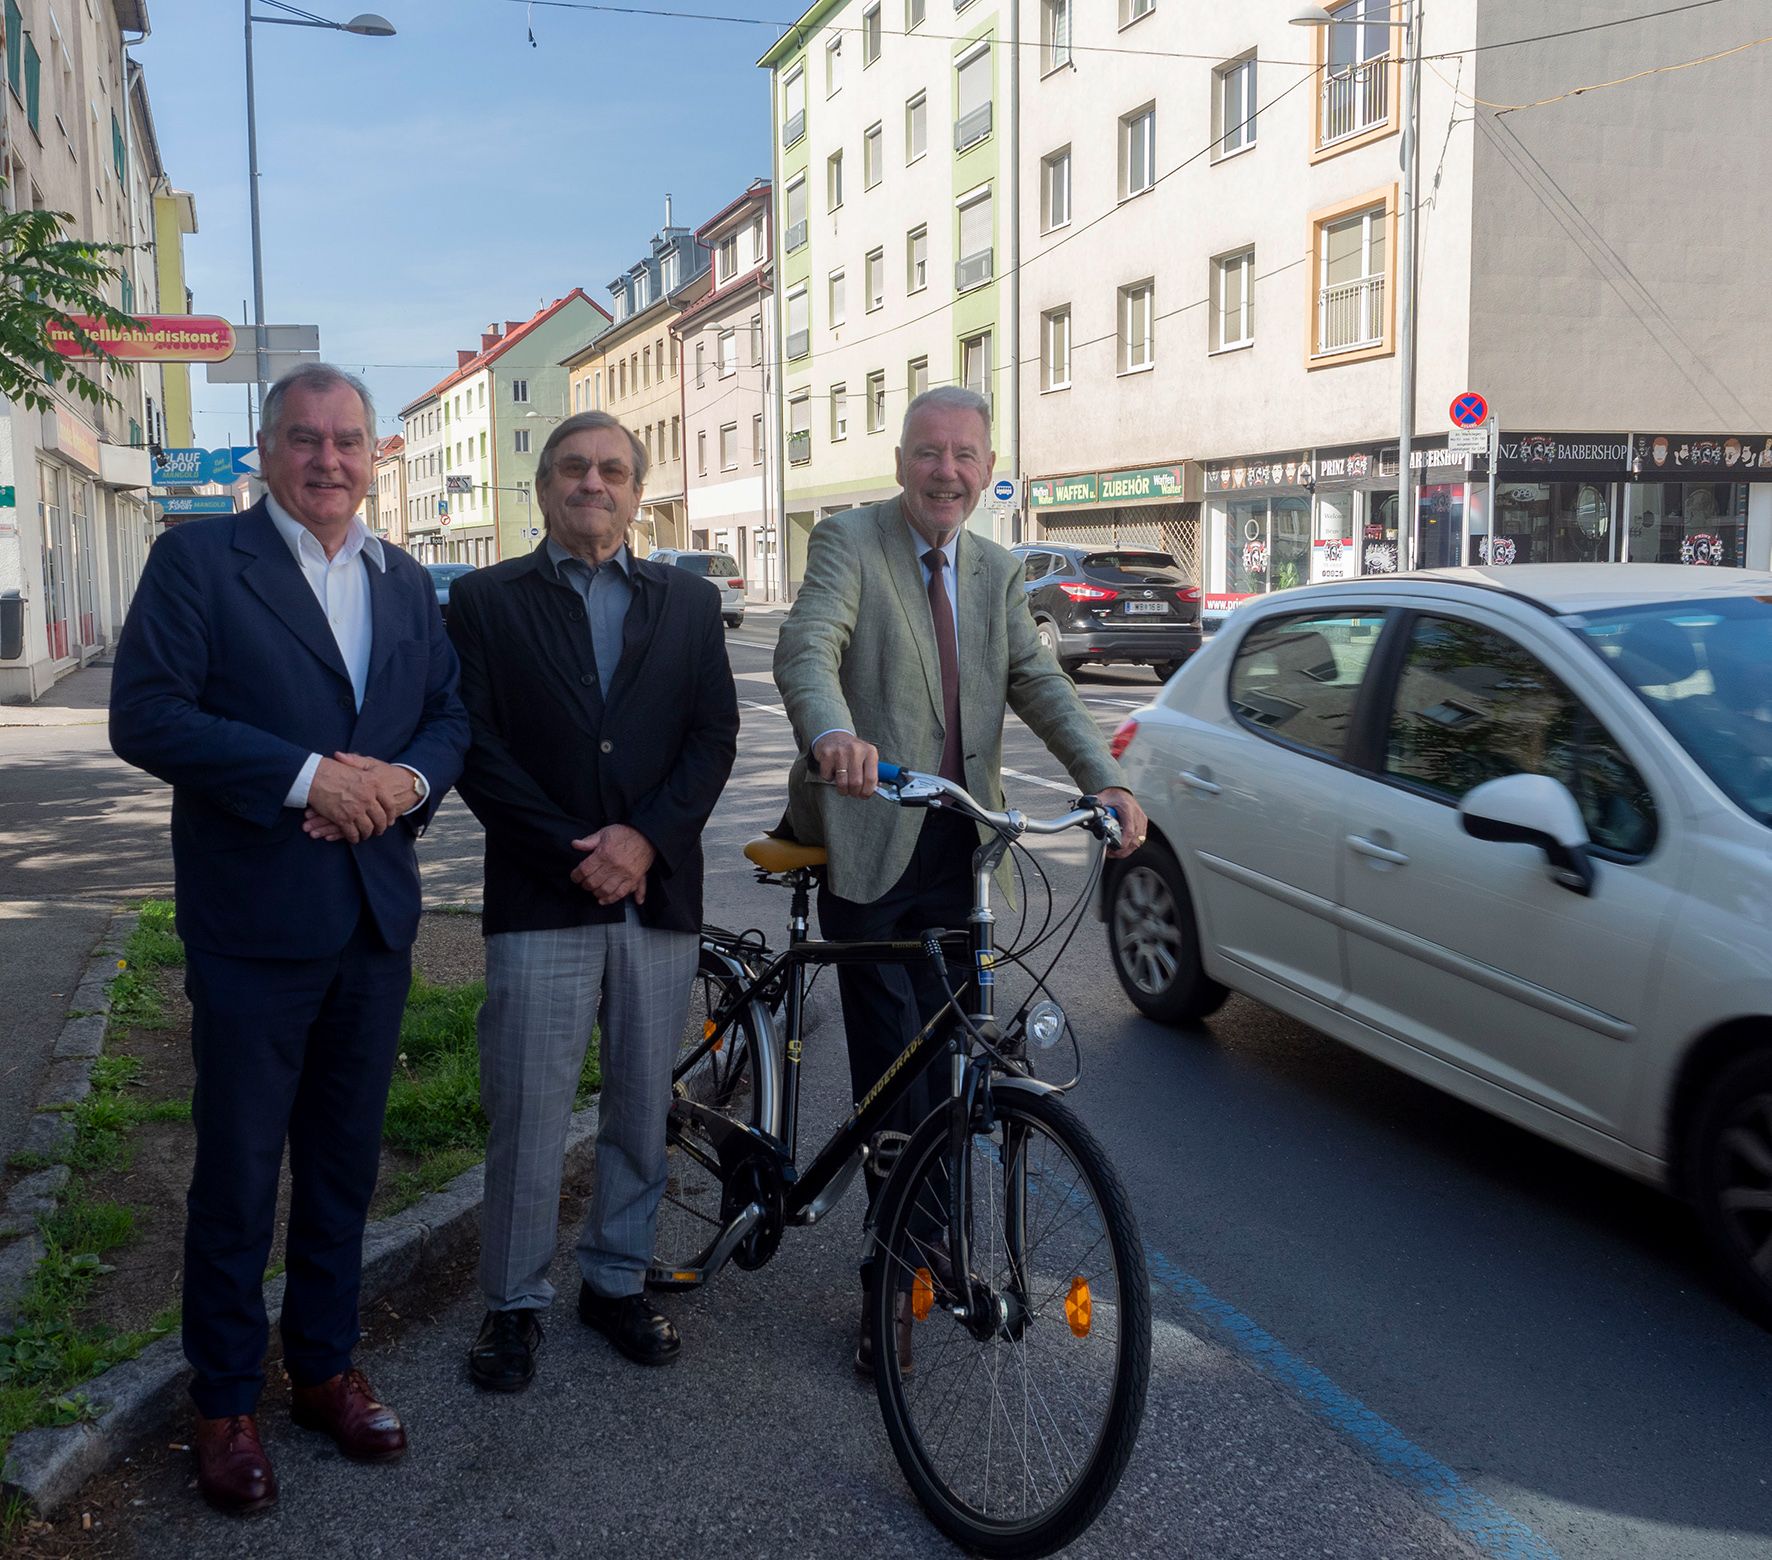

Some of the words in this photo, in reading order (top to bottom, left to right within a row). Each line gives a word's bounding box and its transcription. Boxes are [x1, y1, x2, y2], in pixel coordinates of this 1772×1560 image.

[170, 452, 200, 462] LAUF
[1410, 451, 1465, 468] ARBERSHOP
[1558, 444, 1627, 460] BARBERSHOP
[164, 462, 201, 472] SPORT
[1320, 459, 1345, 476] PRINZ
[1102, 475, 1150, 498] ZUBEHÖR
[1153, 474, 1175, 486] Waffen
[1056, 484, 1088, 501] WAFFEN
[1090, 491, 1096, 499] u.
[1161, 483, 1181, 495] Walter
